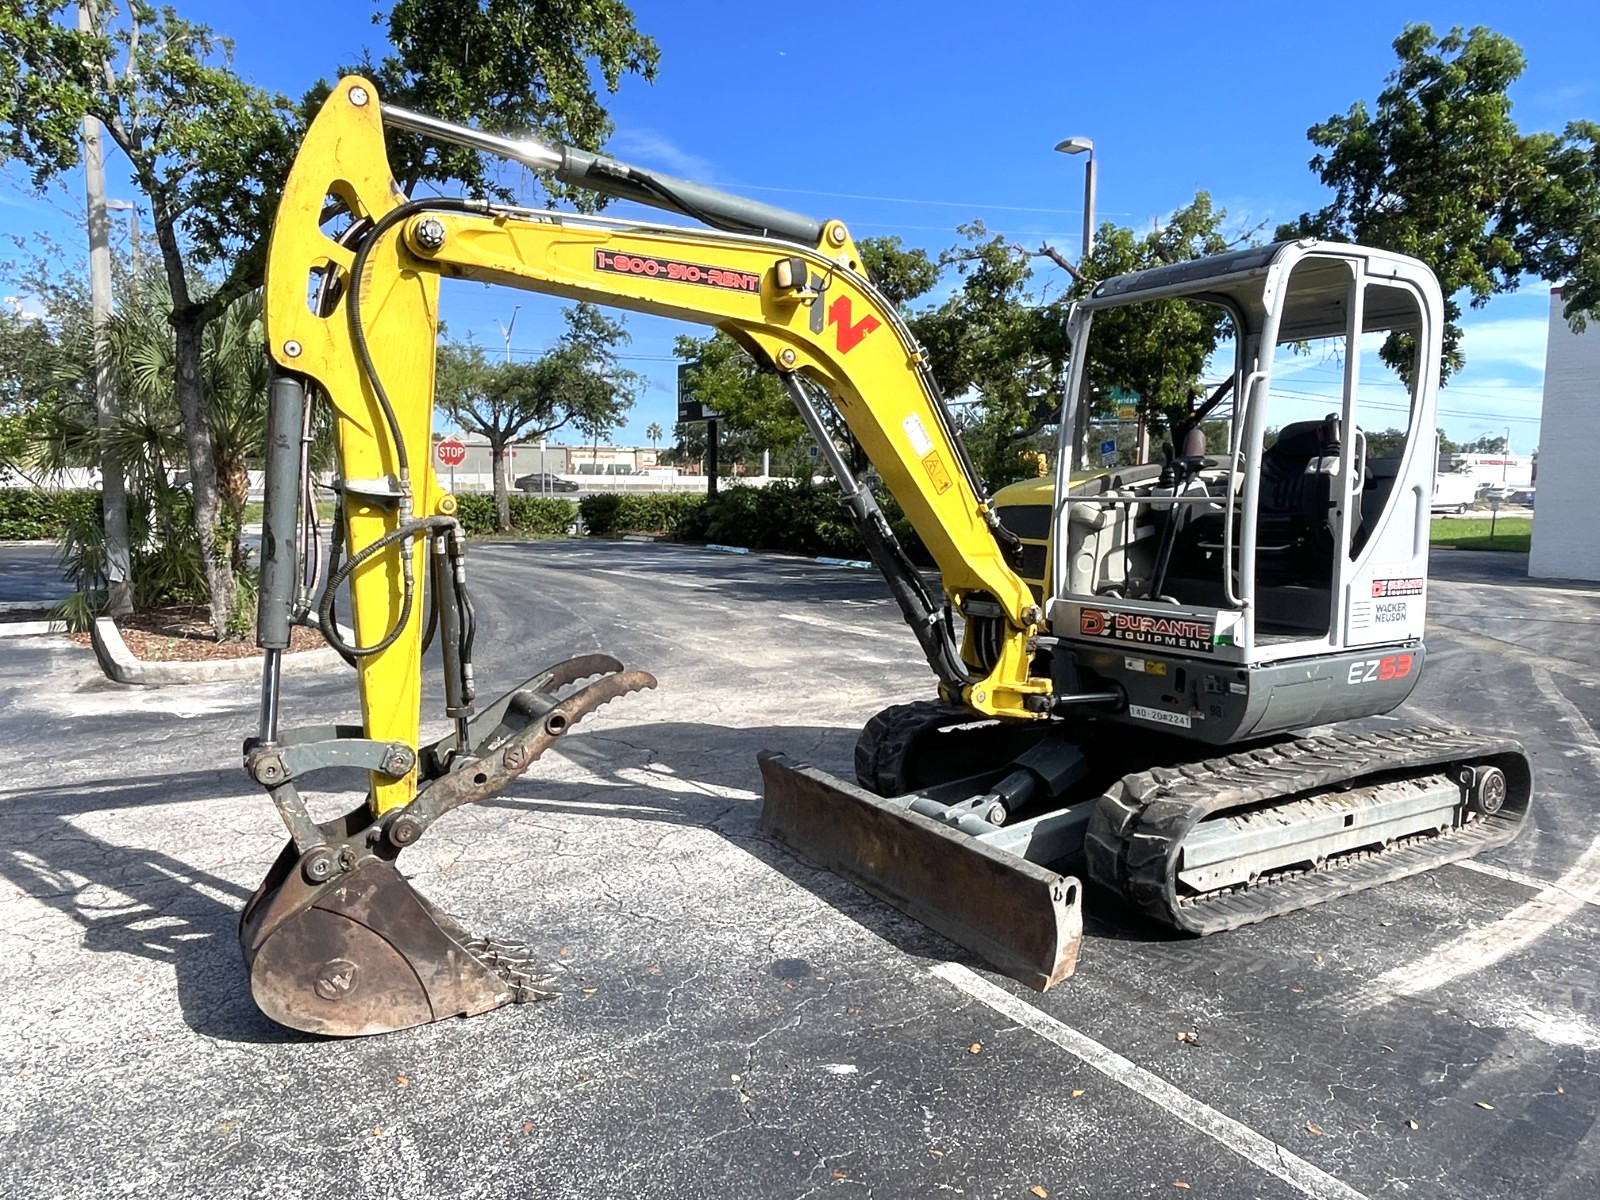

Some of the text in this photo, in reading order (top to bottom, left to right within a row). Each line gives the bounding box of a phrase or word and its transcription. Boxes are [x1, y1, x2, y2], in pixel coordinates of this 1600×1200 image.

[597, 252, 758, 290] 1-800-910-RENT
[440, 441, 464, 458] STOP
[1375, 602, 1407, 613] WACKER
[1375, 612, 1407, 623] NEUSON
[1115, 614, 1211, 640] DURANTE
[1115, 630, 1212, 650] EQUIPMENT
[1347, 654, 1413, 685] EZ53
